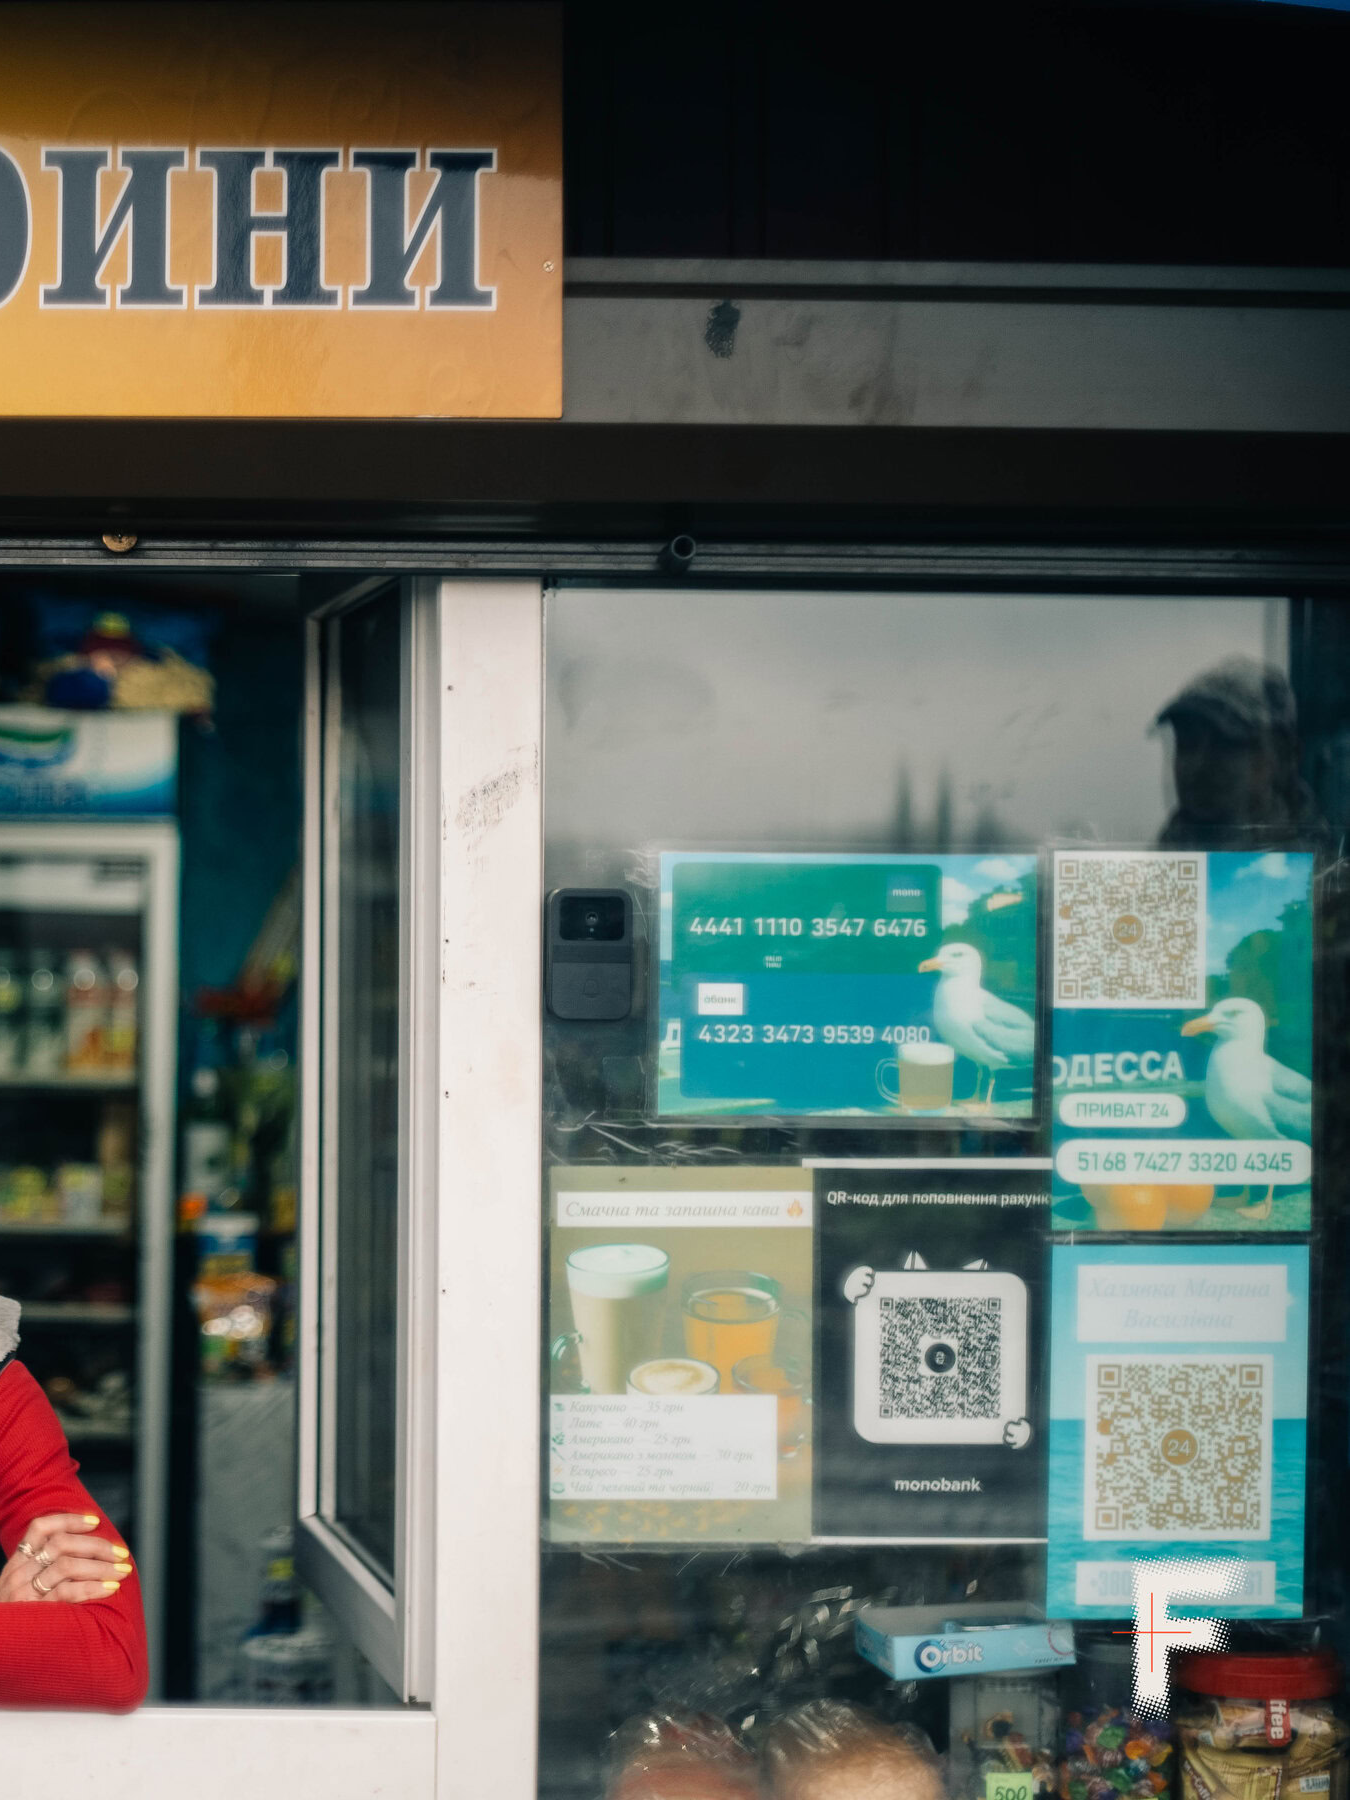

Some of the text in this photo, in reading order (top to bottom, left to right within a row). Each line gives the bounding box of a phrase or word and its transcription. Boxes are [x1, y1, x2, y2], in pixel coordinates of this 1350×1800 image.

[892, 888, 921, 897] mono
[690, 917, 927, 937] 4441 1110 3547 6476
[1118, 923, 1138, 936] 24
[698, 1024, 930, 1044] 4323 3473 9539 4080
[1052, 1051, 1184, 1088] ОДЕССА
[1076, 1102, 1169, 1118] ПРИВАТ 24
[1077, 1152, 1293, 1172] 5168 7427 3320 4345
[827, 1190, 879, 1207] QR-код
[882, 1193, 908, 1207] для
[912, 1193, 997, 1205] поповнення
[565, 1201, 779, 1217] Смачна та запашна кава
[1167, 1440, 1191, 1457] 24
[894, 1477, 982, 1492] monobank
[920, 1642, 984, 1668] Orbit
